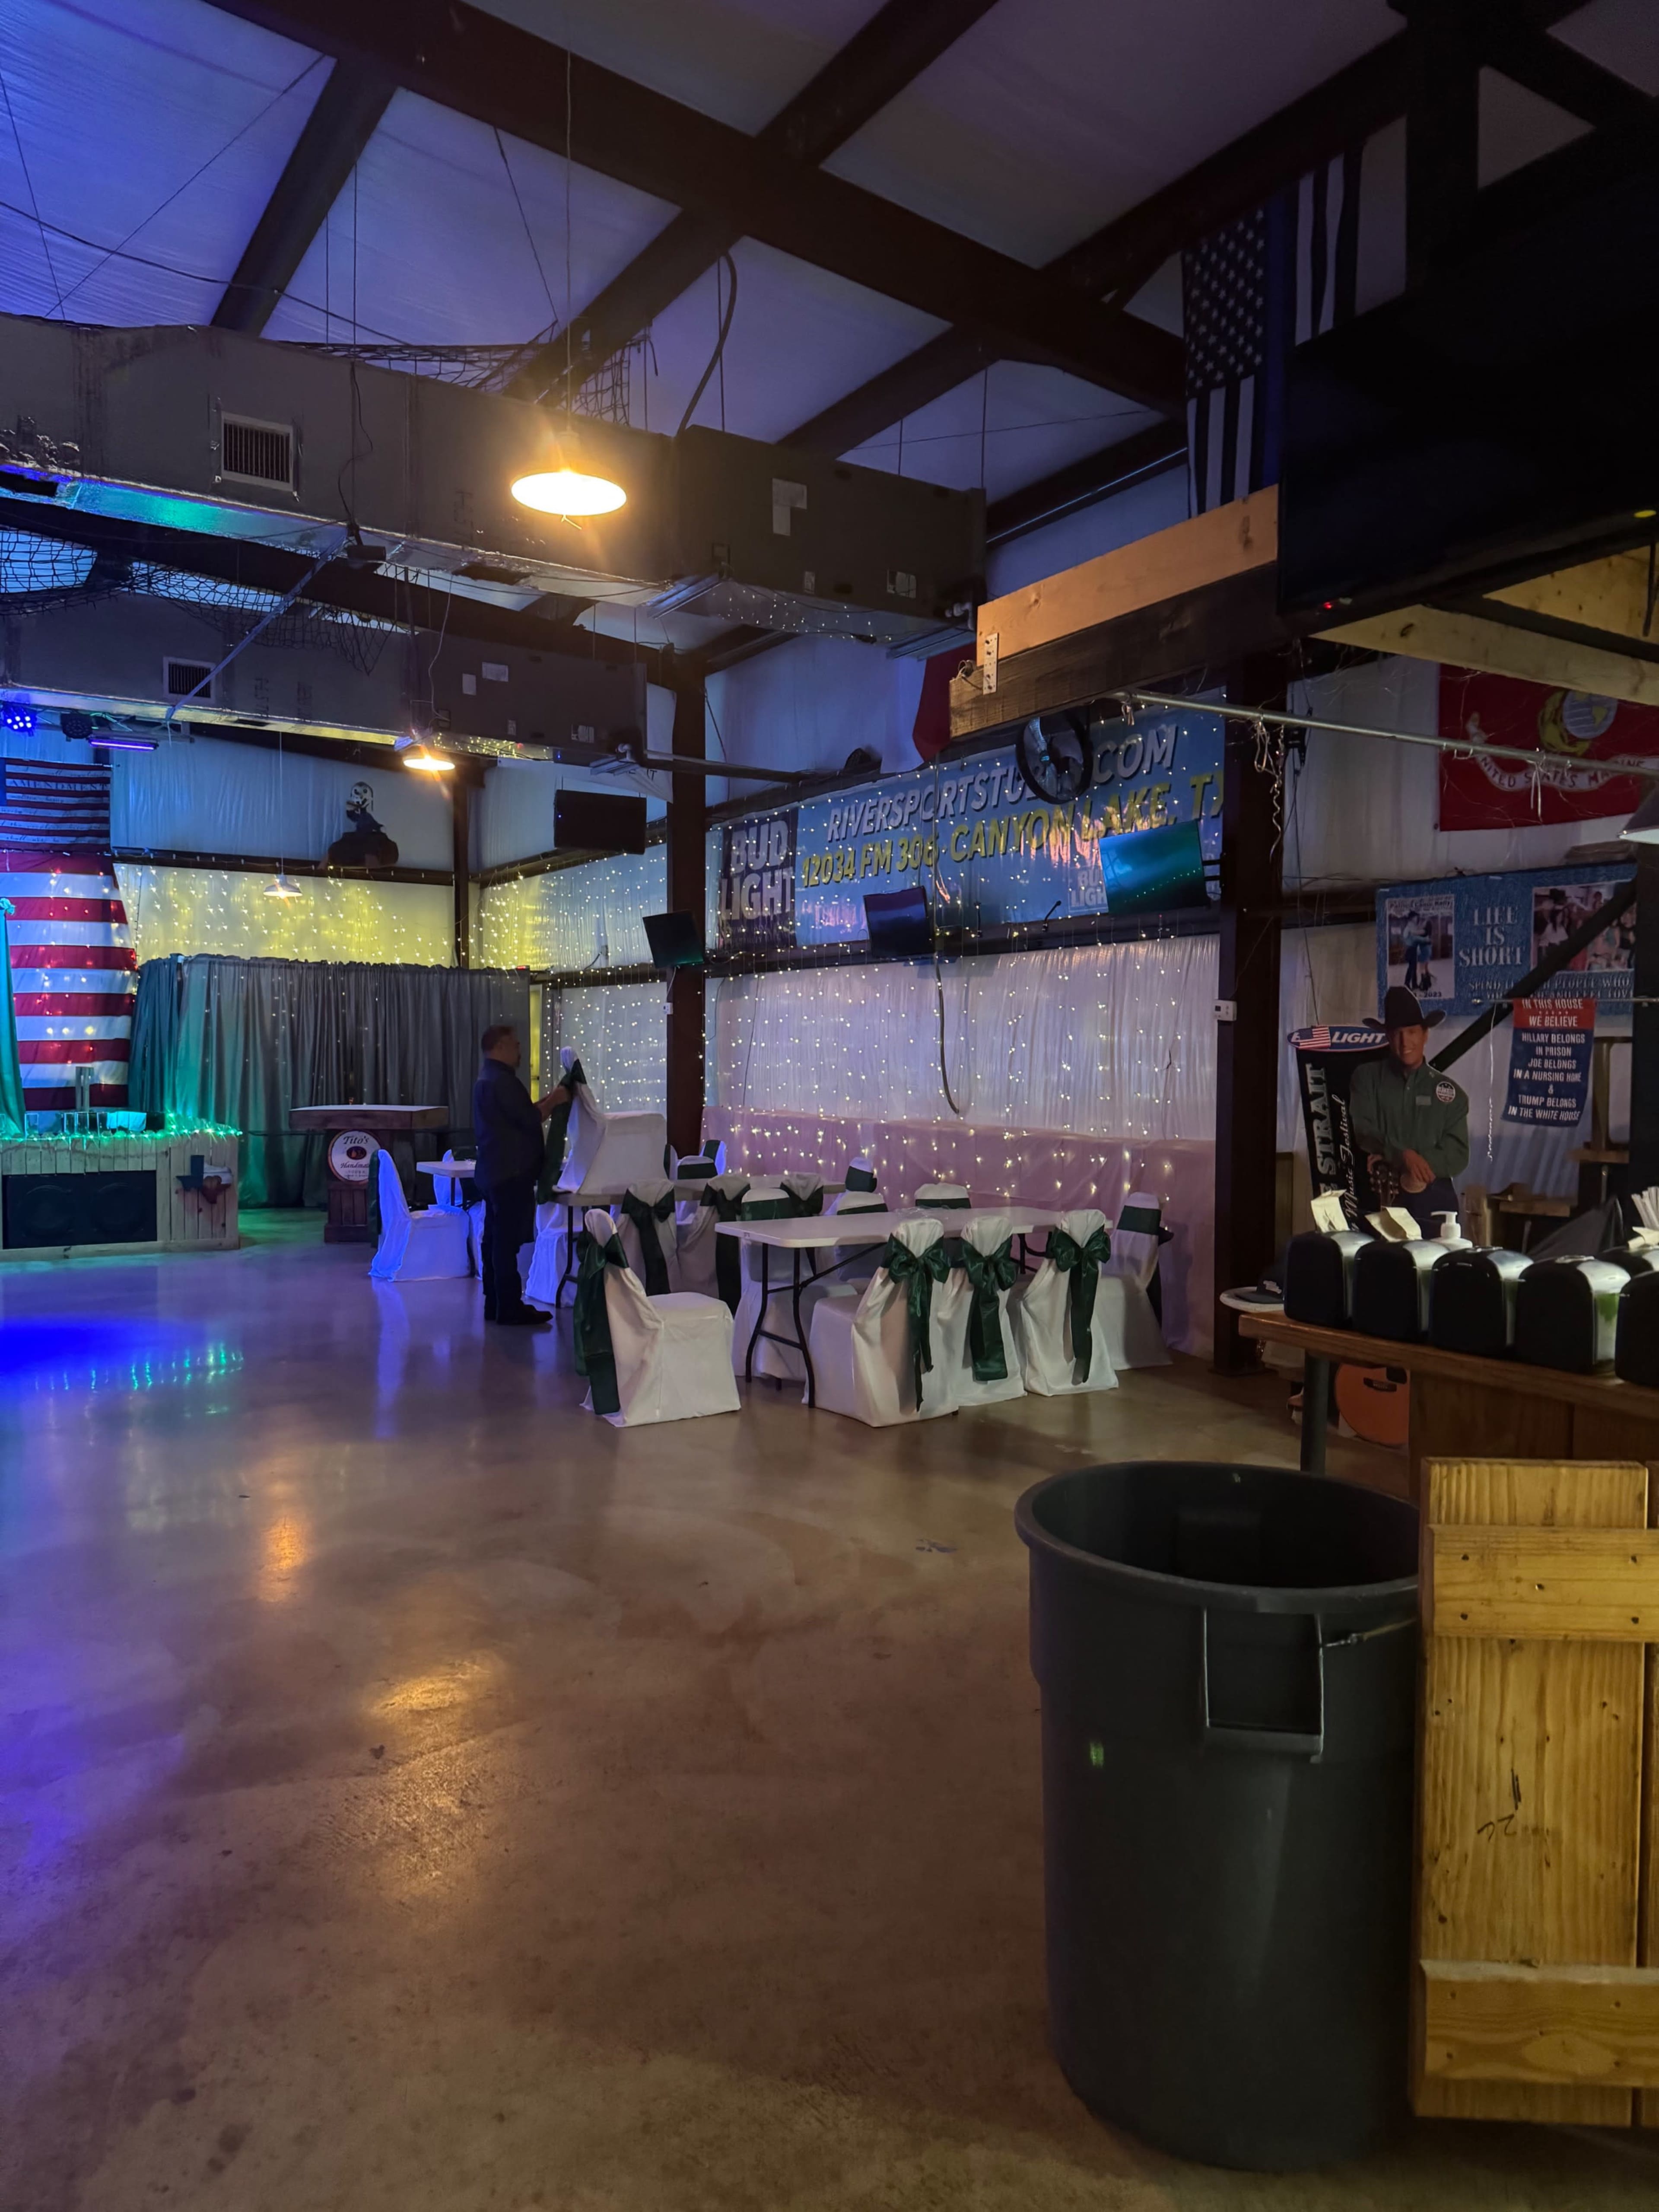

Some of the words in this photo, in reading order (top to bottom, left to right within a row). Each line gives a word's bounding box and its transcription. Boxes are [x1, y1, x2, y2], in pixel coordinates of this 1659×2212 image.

[1480, 756, 1516, 787] NITED
[1524, 769, 1578, 788] SATES
[731, 821, 788, 873] BUD
[803, 848, 856, 888] 12034
[860, 840, 893, 878] FM
[896, 834, 939, 872] 306
[951, 803, 1075, 862] CANYON
[1078, 871, 1103, 888] BU
[720, 866, 793, 920] LIGHT
[1071, 887, 1106, 907] LIGH
[1474, 906, 1517, 926] LIFE
[1485, 927, 1505, 945] IS
[1459, 947, 1525, 968] SHORT
[1602, 977, 1630, 987] WHO
[1522, 999, 1532, 1009] IN
[1534, 999, 1553, 1009] THIS
[1555, 999, 1584, 1009] HOUSE
[1529, 1016, 1541, 1027] WE
[1545, 1016, 1578, 1027] BELIEVE
[1331, 1031, 1386, 1044] LIGHT
[1522, 1032, 1549, 1043] HILLARY
[1551, 1034, 1586, 1044] BELONGS
[1536, 1046, 1543, 1056] IN
[1545, 1046, 1572, 1056] PRISON
[1528, 1058, 1542, 1068] JOE
[1544, 1059, 1577, 1069] BELONGS
[1513, 1068, 1522, 1079] IN
[1524, 1069, 1530, 1079] A
[1532, 1071, 1564, 1082] NURSING
[1566, 1072, 1582, 1082] HOME
[1548, 1084, 1554, 1094] &
[1518, 1094, 1545, 1106] TRUMP
[1547, 1097, 1576, 1108] BELONGS
[1305, 1063, 1336, 1176] STRAIT
[1508, 1106, 1518, 1116] IN
[1519, 1107, 1534, 1118] THE
[1535, 1109, 1559, 1120] WHITE
[1559, 1111, 1581, 1121] HOUSE
[1332, 1094, 1354, 1166] Festival
[343, 1136, 369, 1145] Tito's
[1344, 1168, 1358, 1218] Music
